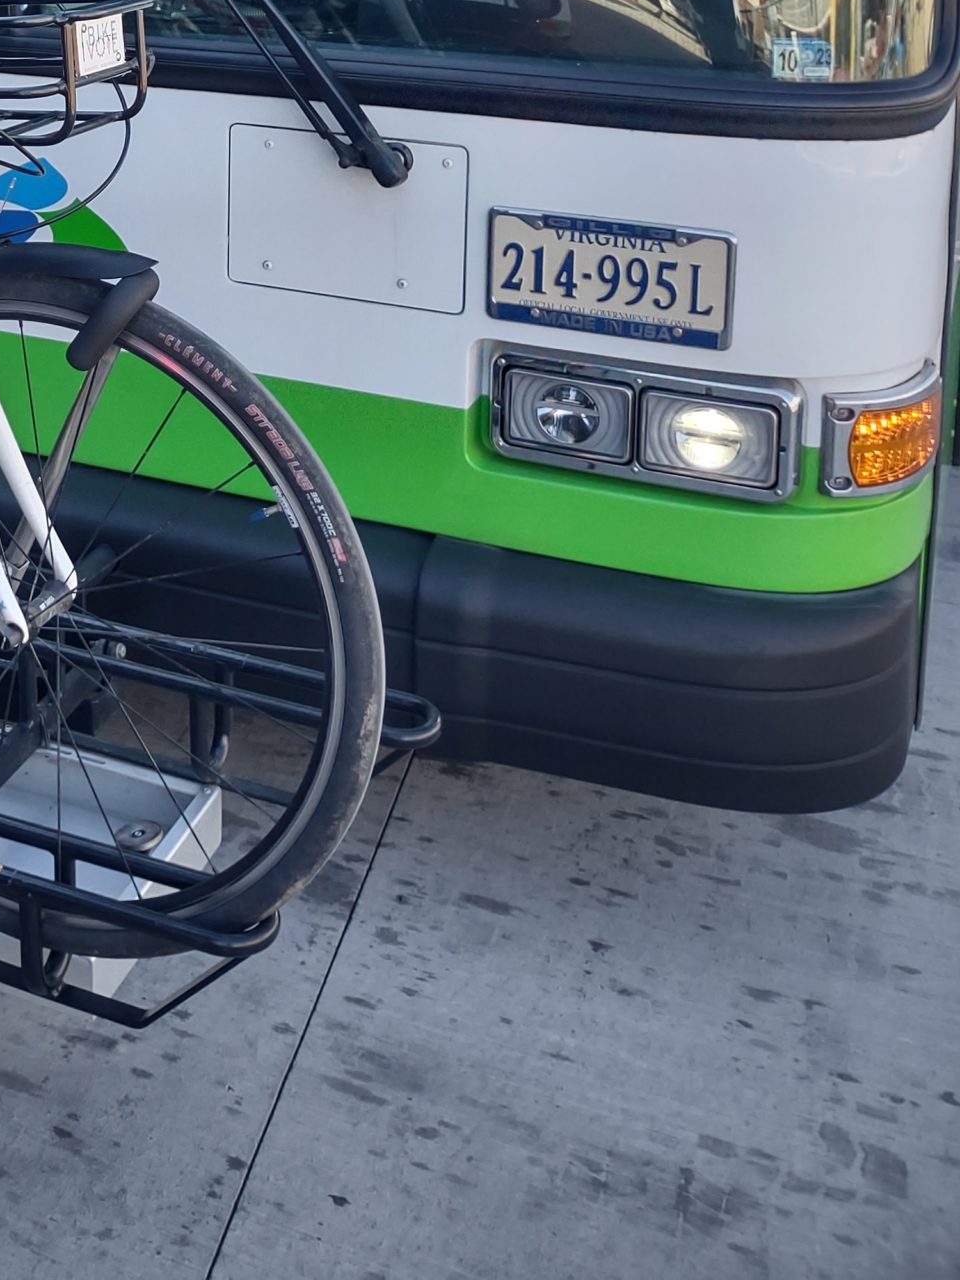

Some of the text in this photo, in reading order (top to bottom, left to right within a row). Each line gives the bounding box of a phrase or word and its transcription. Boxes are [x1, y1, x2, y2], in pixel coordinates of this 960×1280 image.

[779, 49, 798, 72] 10
[553, 229, 667, 254] VIRGINIA
[500, 242, 714, 317] 214-995L
[540, 310, 671, 340] MADE IN USA
